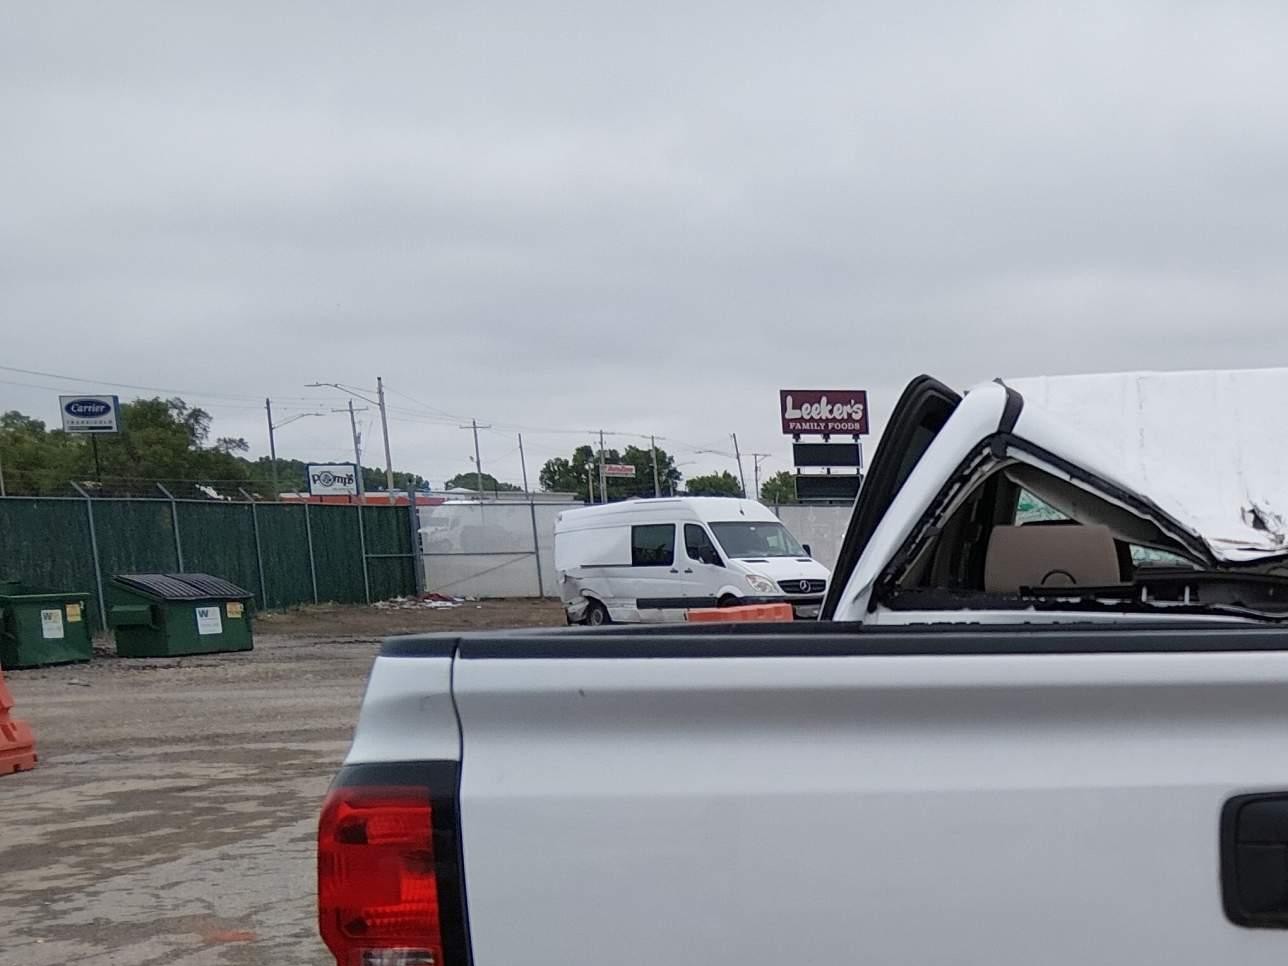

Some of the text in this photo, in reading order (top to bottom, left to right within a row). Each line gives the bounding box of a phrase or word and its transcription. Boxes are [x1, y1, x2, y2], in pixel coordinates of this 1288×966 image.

[71, 403, 106, 413] Carrier
[785, 395, 864, 420] Leeker's
[789, 422, 860, 430] FAMILY FOODS
